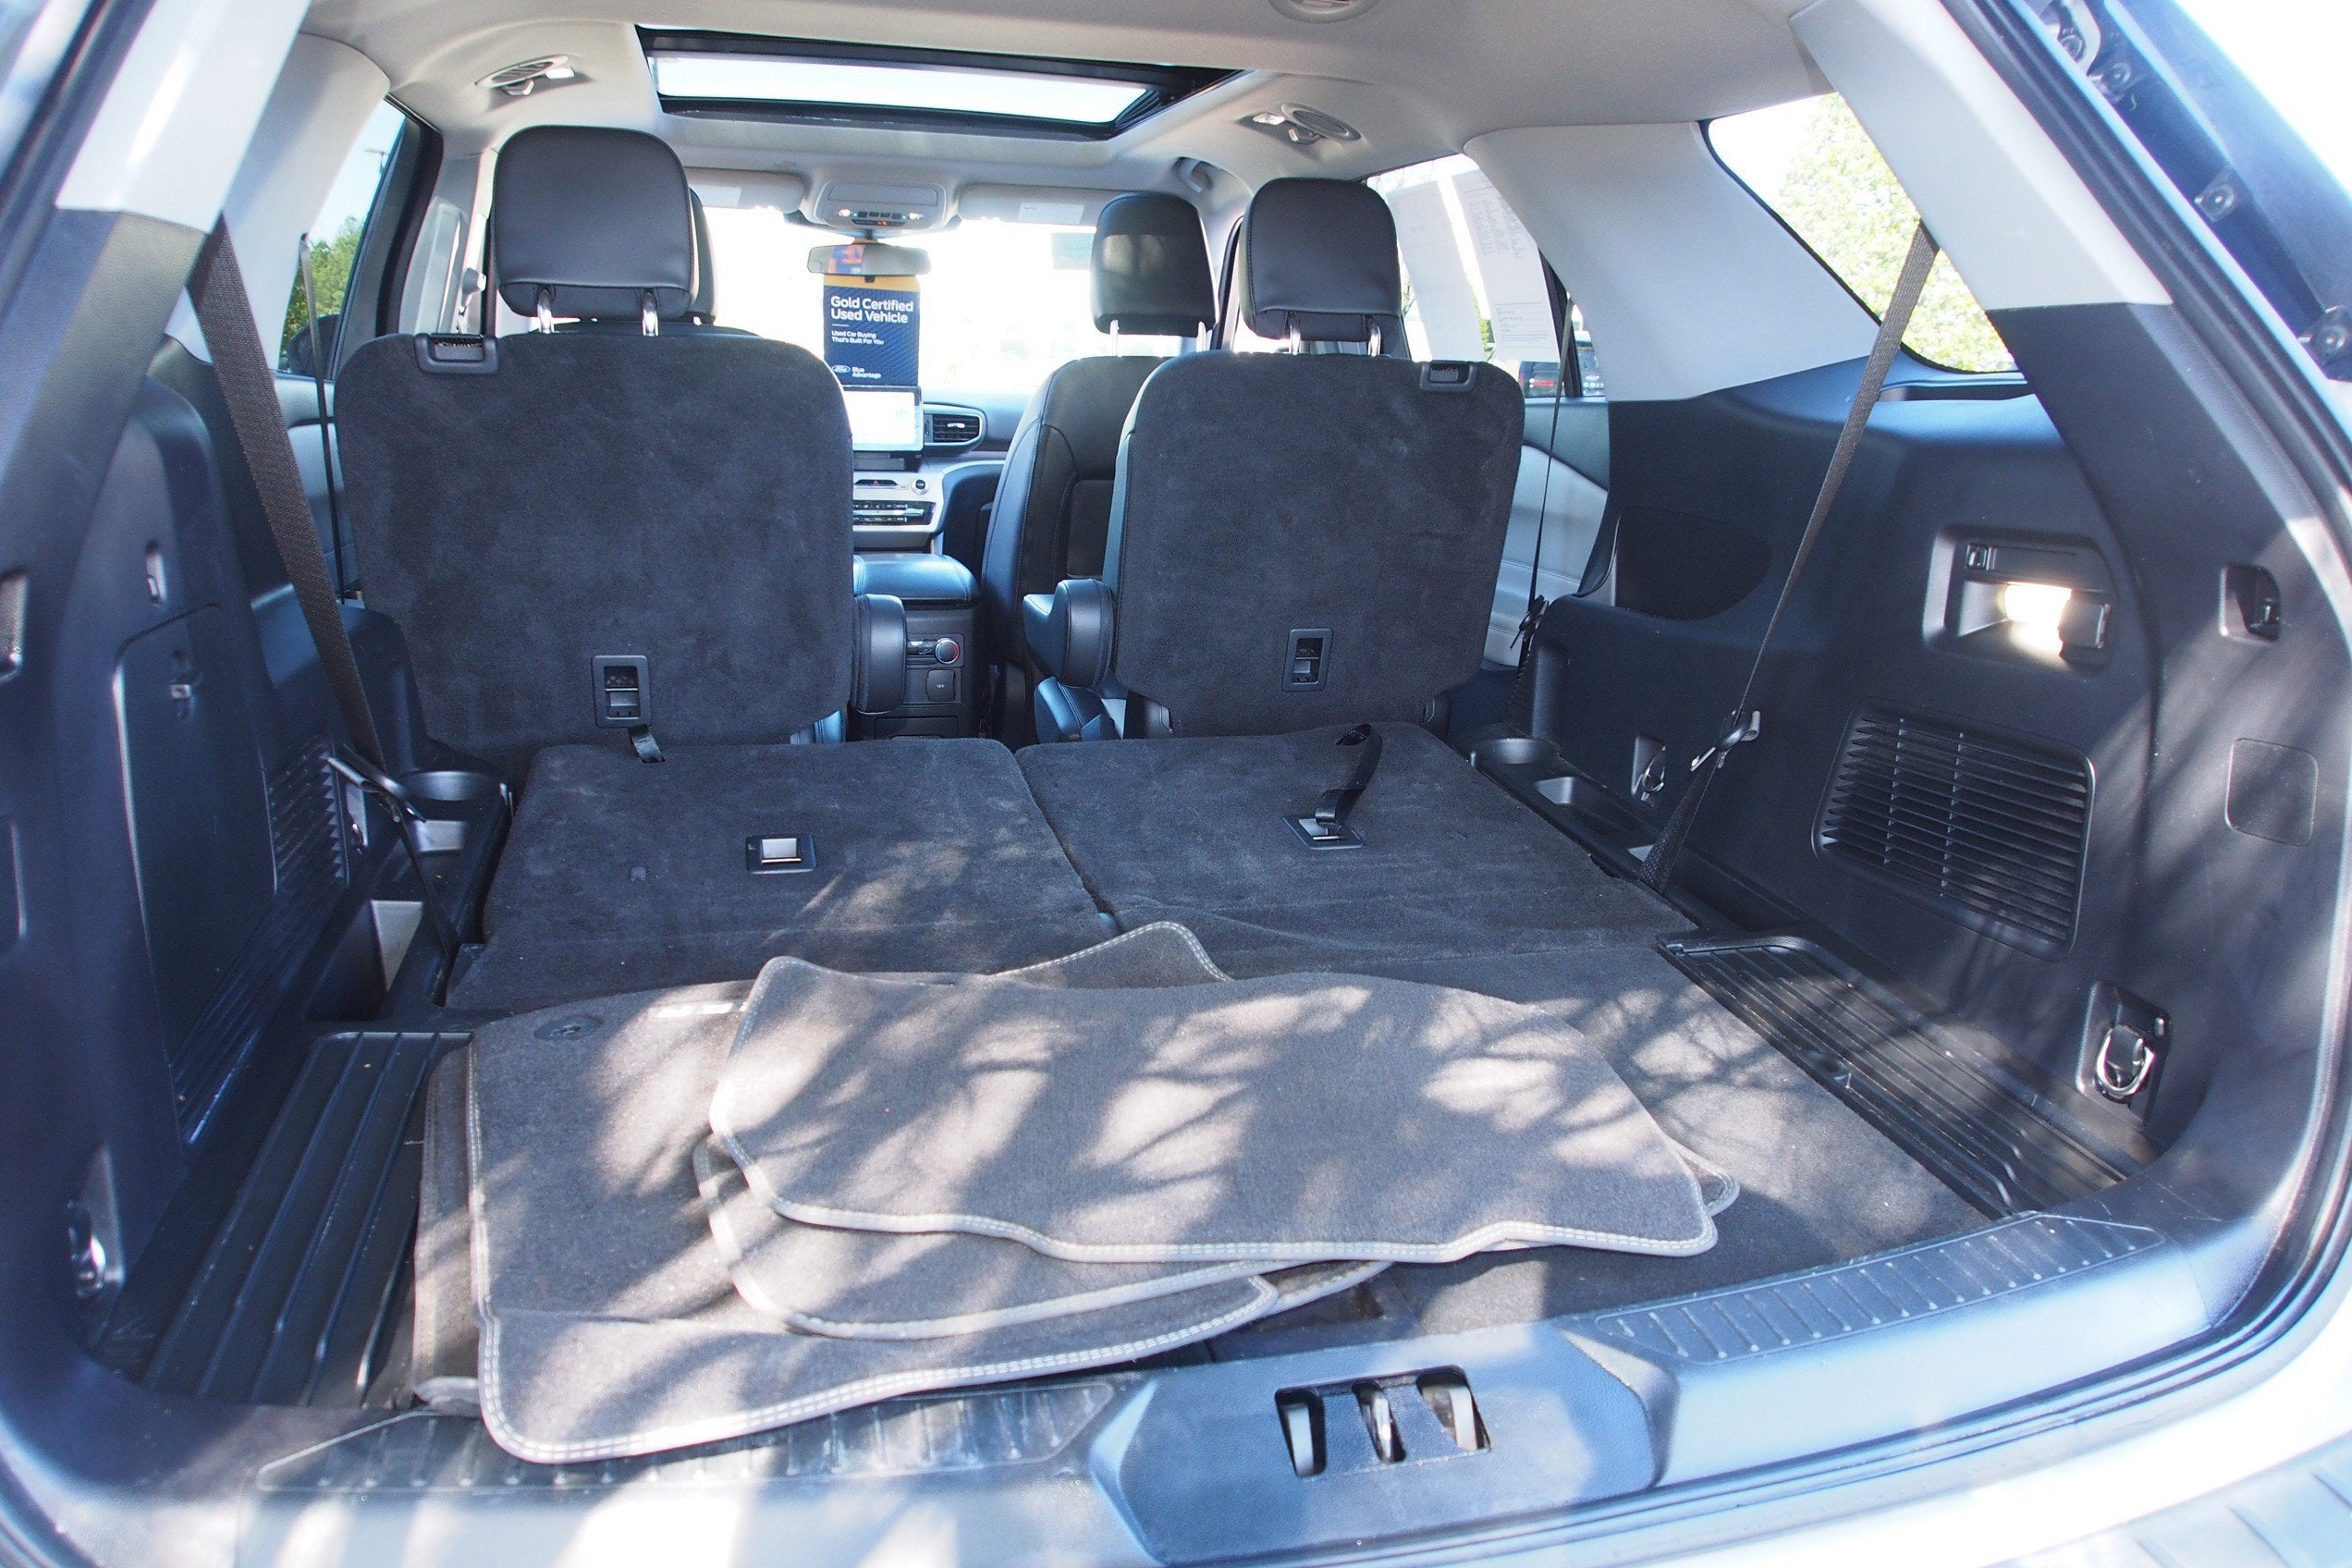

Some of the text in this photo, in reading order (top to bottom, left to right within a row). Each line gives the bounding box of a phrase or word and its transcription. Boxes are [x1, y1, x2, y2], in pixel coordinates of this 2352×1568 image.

[830, 295, 914, 312] Gold Certified
[830, 308, 909, 324] Used Vehicle
